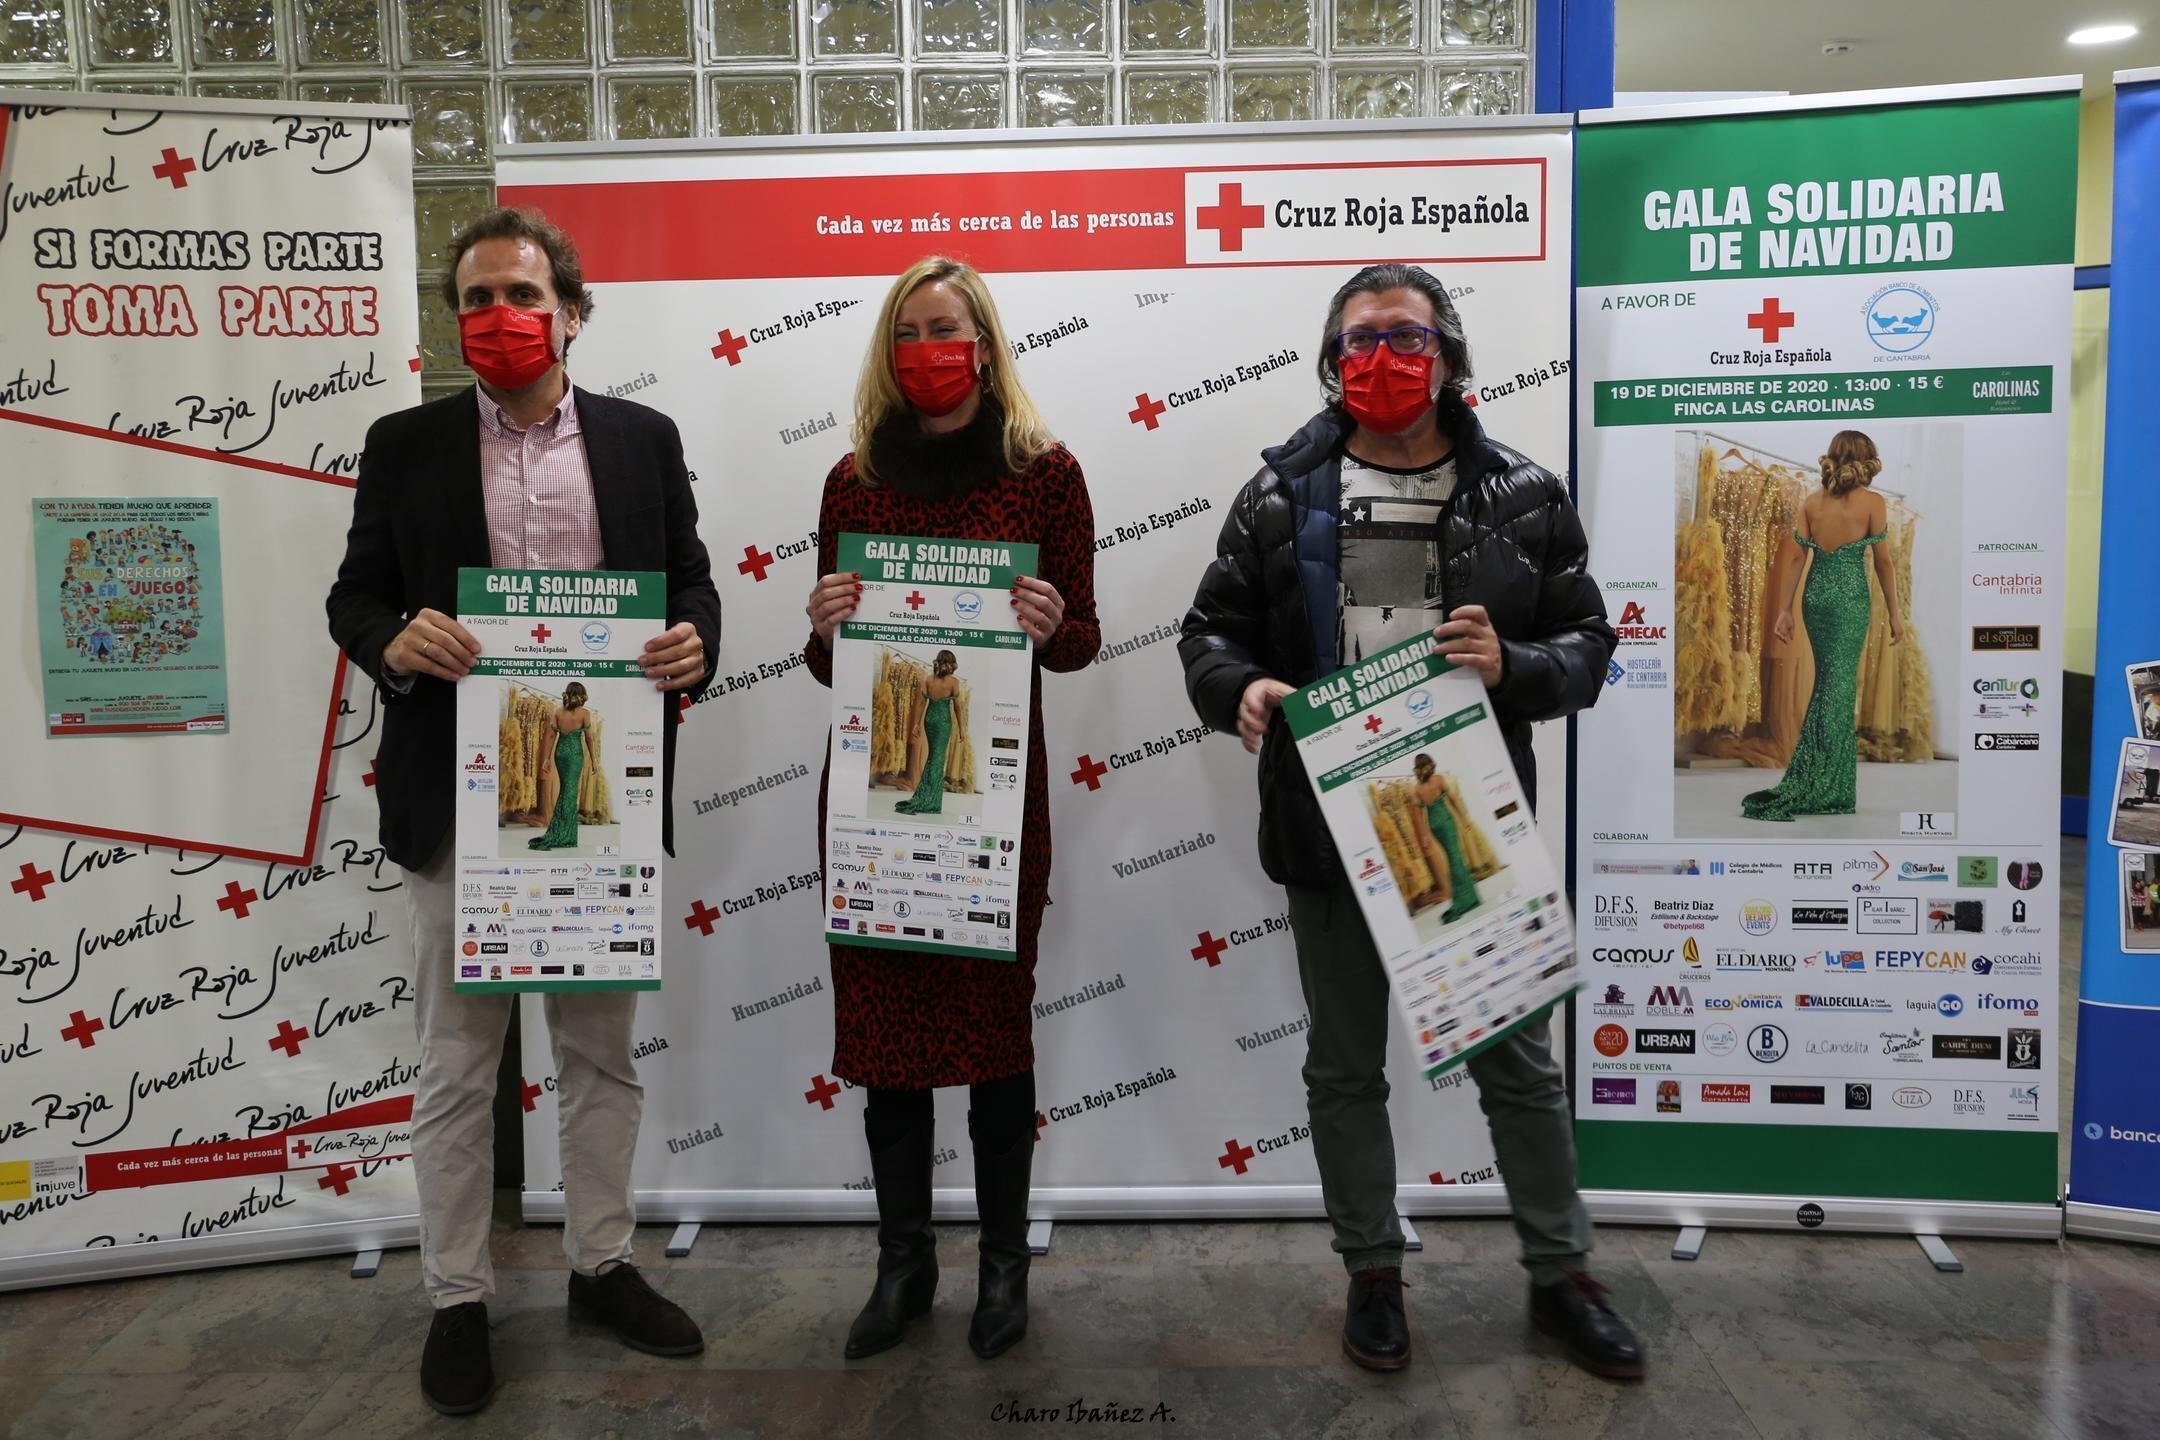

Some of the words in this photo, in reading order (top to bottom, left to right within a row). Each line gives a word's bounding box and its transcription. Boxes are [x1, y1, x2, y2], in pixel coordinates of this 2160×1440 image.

[201, 128, 278, 172] Cruz
[273, 116, 351, 160] Roja
[1643, 186, 1752, 231] GALA
[1767, 172, 2004, 225] SOLIDARIA
[816, 215, 863, 235] Cada
[872, 217, 902, 234] vez
[911, 212, 951, 232] más
[959, 216, 1012, 231] cerca
[1020, 211, 1042, 230] de
[1051, 210, 1079, 229] las
[1087, 209, 1174, 233] personas
[1275, 200, 1336, 228] Cruz
[1344, 197, 1404, 233] Roja
[1412, 195, 1529, 233] Española
[34, 229, 76, 269] SI
[91, 230, 248, 270] FORMAS
[264, 231, 383, 270] PARTE
[1689, 232, 1743, 272] DE
[1759, 221, 1954, 269] NAVIDAD
[37, 285, 198, 337] TOMA
[219, 285, 379, 337] PARTE
[1601, 298, 1612, 310] A
[1617, 294, 1669, 309] FAVOR
[1674, 293, 1696, 307] DE
[749, 326, 782, 345] Cruz
[782, 308, 816, 334] Roja
[1026, 316, 1089, 349] Española
[1710, 352, 1739, 365] Cruz
[1743, 350, 1772, 367] Roja
[1775, 349, 1832, 366] Española
[1886, 354, 1931, 362] CANTABRIA
[1168, 389, 1201, 410] Cruz
[1202, 374, 1237, 400] Roja
[1238, 347, 1299, 382] Española
[1481, 380, 1514, 403] Cruz
[1516, 368, 1551, 392] Roja
[1611, 386, 1629, 399] 19
[1634, 385, 1656, 398] DE
[1661, 381, 1754, 397] DICIEMBRE
[1760, 381, 1782, 394] DE
[1787, 380, 1829, 393] 2020
[1845, 377, 1891, 392] 13:00
[1908, 376, 1928, 390] 15
[1933, 375, 1944, 389] €
[1973, 380, 2040, 398] CAROLINAS
[176, 396, 255, 438] Roja
[216, 352, 387, 453] Juventud
[1674, 403, 1726, 416] FINCA
[1732, 401, 1766, 415] LAS
[1771, 397, 1875, 415] CAROLINAS
[779, 412, 838, 446] Unidad
[1116, 520, 1149, 546] Roja
[1148, 495, 1211, 532] Española
[776, 538, 808, 561] Cruz
[865, 541, 910, 561] GALA
[916, 544, 1011, 567] SOLIDARIA
[1978, 543, 2038, 551] PATROCINAN
[117, 567, 189, 578] DERECHOS
[883, 562, 906, 579] DE
[912, 563, 990, 585] NAVIDAD
[1972, 574, 2042, 586] Cantabria
[128, 581, 186, 596] JUEGO
[486, 575, 533, 594] GALA
[539, 576, 638, 596] SOLIDARIA
[2000, 587, 2042, 595] Infinita
[505, 595, 529, 613] DE
[536, 596, 618, 615] NAVIDAD
[914, 636, 956, 645] CAROLINAS
[726, 671, 759, 692] Roja
[1307, 676, 1351, 709] GALA
[1330, 697, 1355, 719] DE
[1358, 661, 1429, 707] NAVIDAD
[1110, 752, 1143, 771] Cruz
[1143, 735, 1177, 758] Roja
[693, 762, 809, 816] Independencia
[1593, 833, 1649, 841] COLABORAN
[59, 840, 138, 882] Cruz
[1112, 831, 1216, 879] Voluntariado
[1843, 859, 1878, 871] pitma
[1913, 864, 1927, 873] San
[723, 891, 756, 915] Cruz
[756, 875, 788, 901] Roja
[1595, 895, 1638, 914] D.F.S.
[1654, 901, 1689, 910] Beatriz
[1594, 916, 1638, 927] DIFUSION
[1230, 926, 1263, 945] Cruz
[18, 894, 194, 1003] Juventud
[1593, 948, 1675, 963] camus
[1716, 953, 1738, 967] EL
[1739, 953, 1796, 967] DIARIO
[1825, 951, 1865, 969] lupa
[1875, 951, 1966, 969] FEPYCAN
[1994, 952, 2041, 964] cocahi
[218, 912, 389, 1018] Juventud
[180, 966, 257, 1006] Roja
[1033, 973, 1126, 1019] Neutralidad
[110, 988, 184, 1029] Cruz
[731, 977, 823, 1022] Humanidad
[1647, 1006, 1679, 1014] DOBLE
[1810, 997, 1869, 1008] VALDECILLA
[1978, 993, 2039, 1010] ifomo
[315, 998, 384, 1037] Cruz
[1641, 1033, 1690, 1047] URBAN
[1762, 1028, 1774, 1049] B
[32, 1094, 113, 1132] Roja
[73, 1037, 245, 1147] Juventud
[1049, 1101, 1082, 1122] Cruz
[1082, 1089, 1115, 1110] Roja
[1115, 1067, 1176, 1098] Española
[347, 1132, 379, 1152] Roja
[667, 1123, 724, 1155] Unidad
[1256, 1133, 1287, 1156] Cruz
[117, 1162, 140, 1171] Cada
[144, 1161, 159, 1170] vez
[162, 1156, 181, 1167] más
[184, 1156, 209, 1165] cerca
[213, 1154, 223, 1163] de
[227, 1152, 240, 1161] las
[243, 1147, 283, 1162] personas
